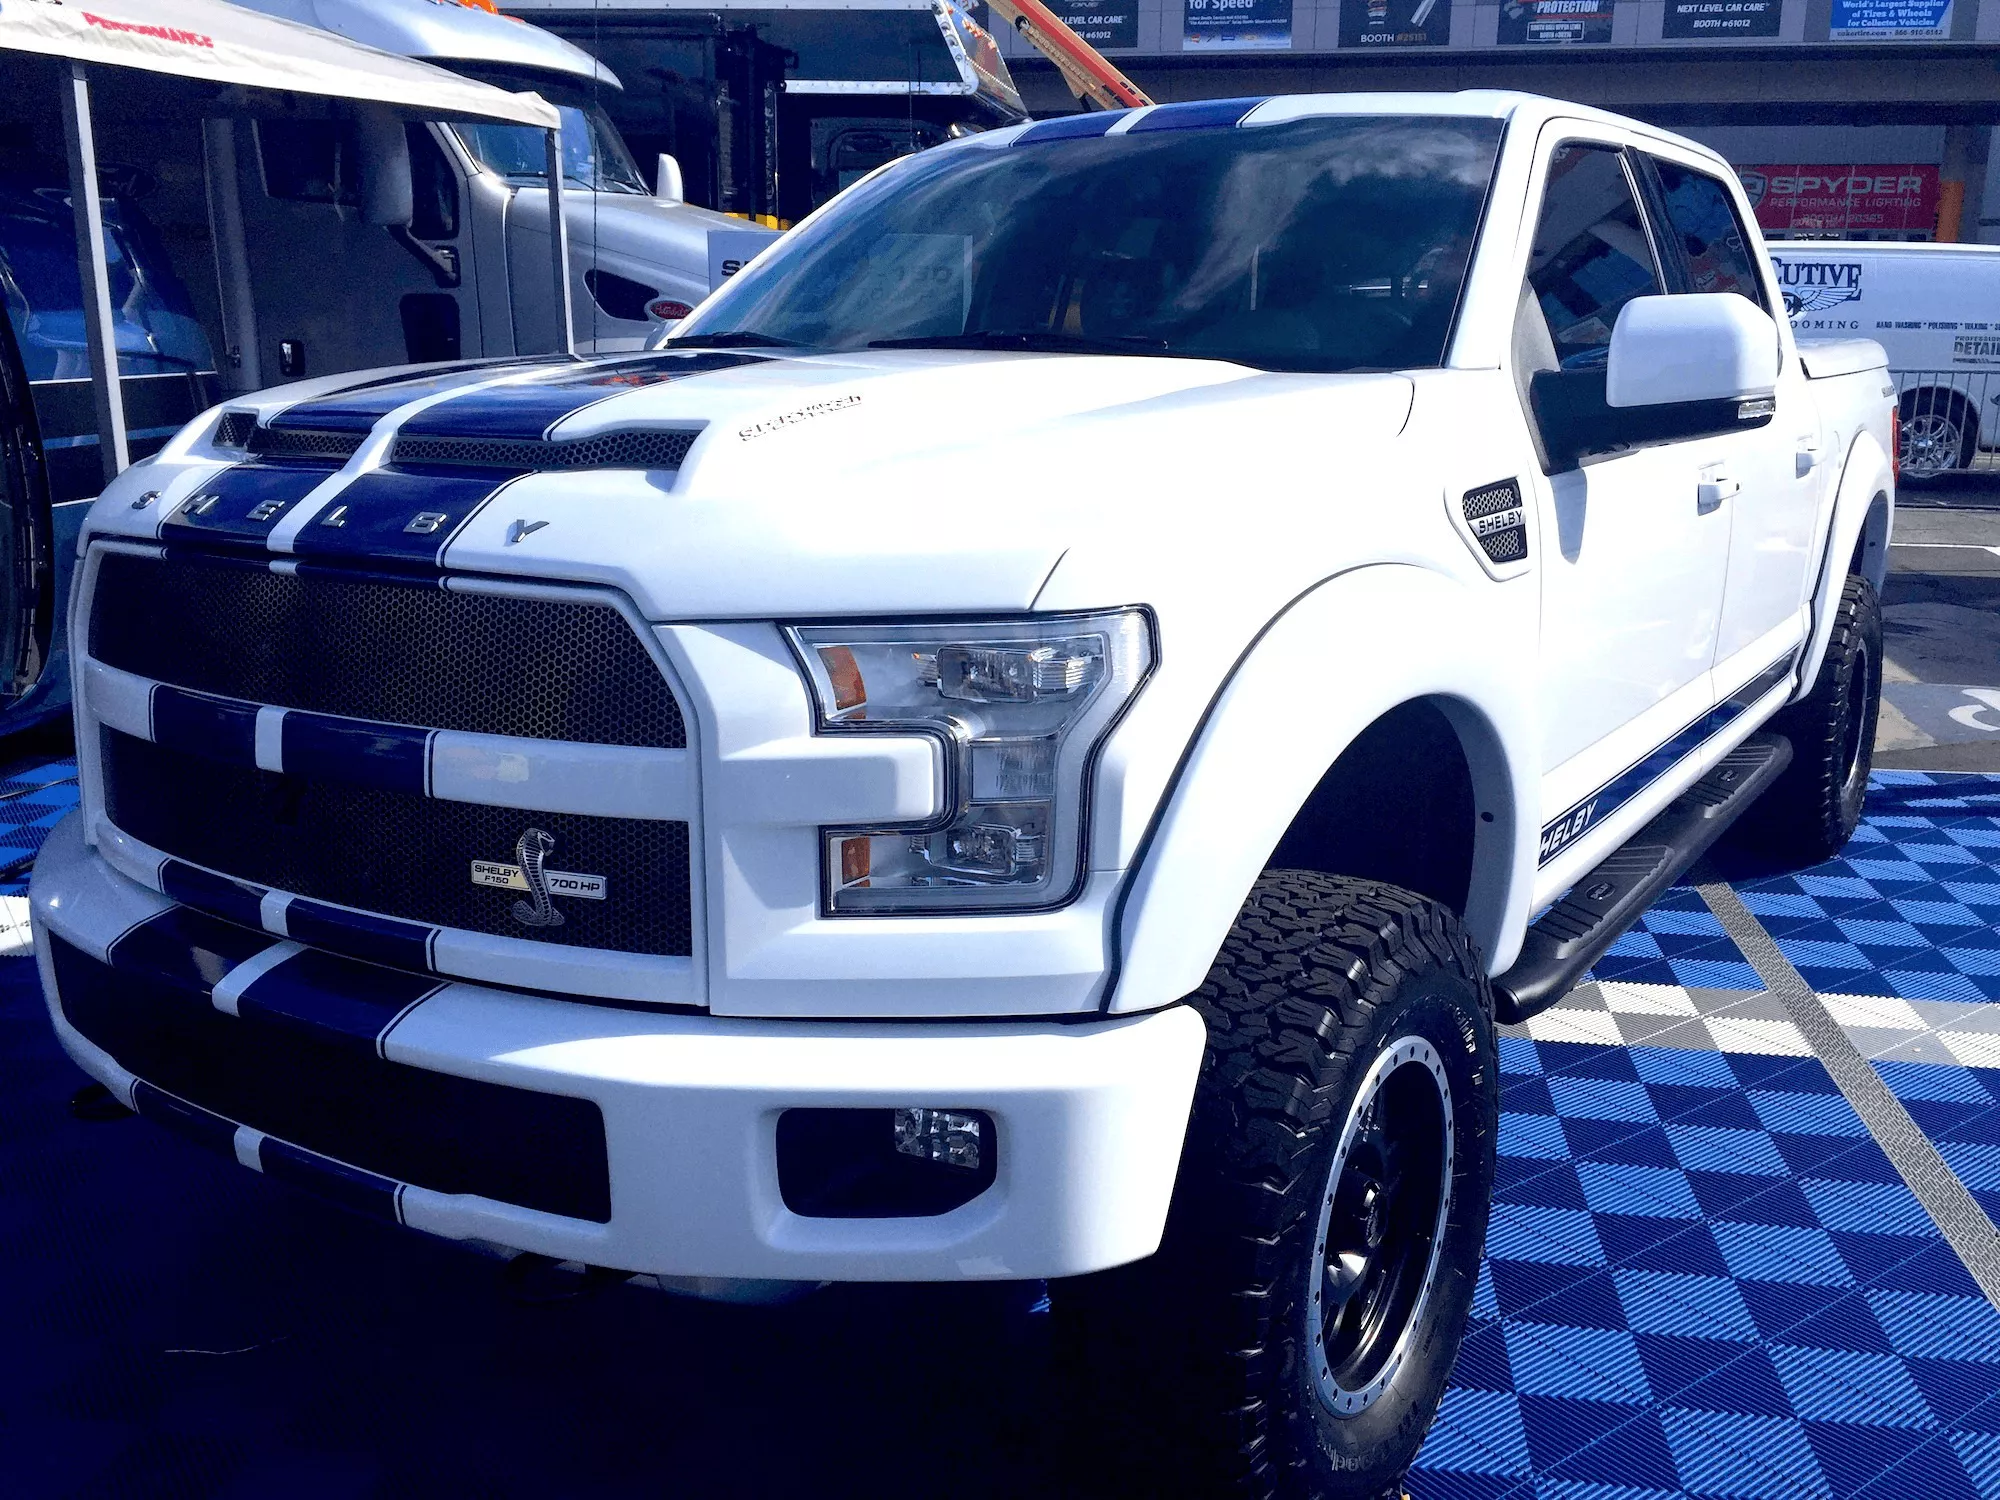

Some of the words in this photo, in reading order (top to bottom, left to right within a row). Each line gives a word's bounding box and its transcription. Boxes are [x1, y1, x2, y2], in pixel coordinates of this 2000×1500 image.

[1188, 0, 1207, 9] for
[1211, 0, 1254, 11] Speed
[1536, 0, 1600, 13] PROTECTION
[1677, 5, 1699, 13] NEXT
[1699, 4, 1724, 12] LEVEL
[1725, 4, 1742, 12] CAR
[1743, 3, 1766, 11] CARE
[1842, 0, 1874, 8] World's
[1875, 0, 1906, 9] Largest
[1907, 0, 1945, 8] Supplier
[1852, 10, 1861, 18] of
[1862, 9, 1887, 18] Tires
[1888, 9, 1896, 18] &
[1898, 8, 1933, 17] Wheels
[1064, 16, 1086, 24] LEVEL
[1087, 16, 1103, 24] CAR
[1104, 15, 1123, 24] CARE
[1693, 20, 1721, 28] BOOTH
[1722, 19, 1751, 27] #61012
[1847, 19, 1860, 27] for
[1861, 18, 1897, 27] Collector
[1899, 17, 1935, 26] Vehicles
[80, 11, 214, 49] PERFORMANCE
[1086, 31, 1111, 39] #61012
[1360, 33, 1395, 43] BOOTH
[1770, 176, 1923, 194] SPYDER
[1770, 198, 1861, 208] PERFORMANCE
[1865, 198, 1922, 208] LIGHTING
[131, 490, 550, 544] SHELBY
[1478, 510, 1523, 534] SHELBY
[474, 864, 519, 878] SHELBY
[484, 874, 509, 884] F150
[550, 878, 578, 890] 700
[580, 882, 600, 892] HP
